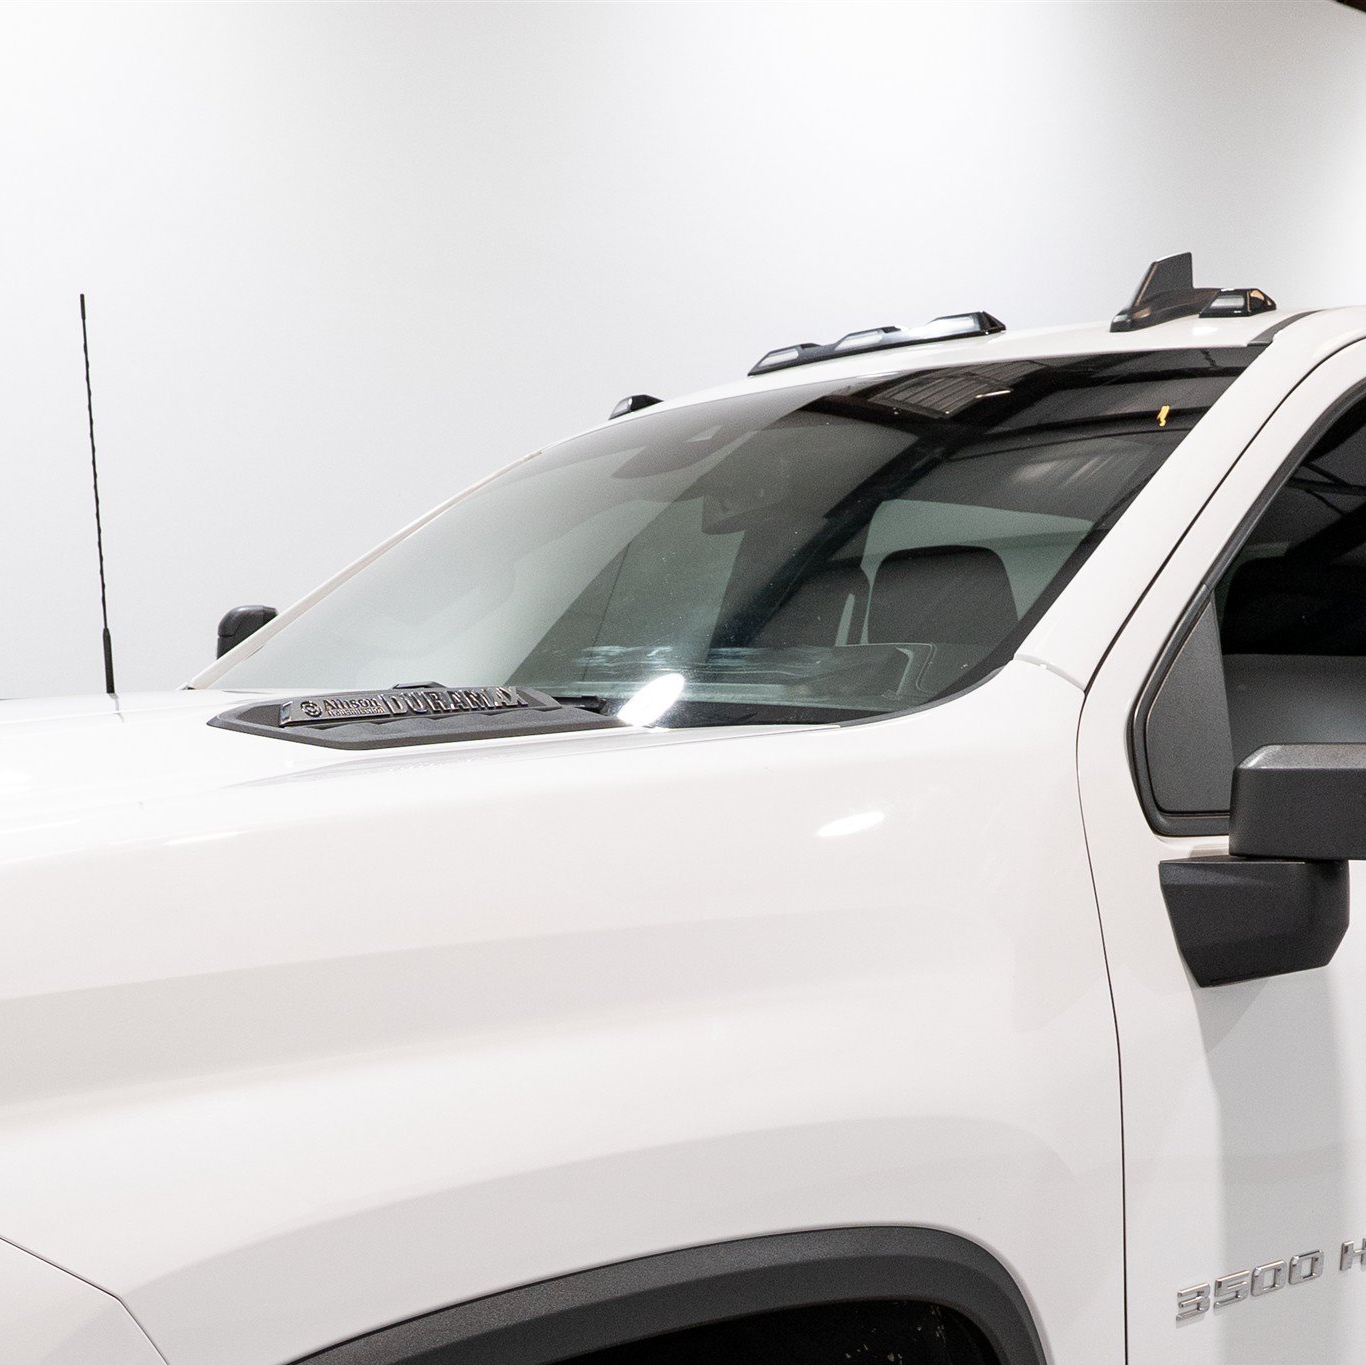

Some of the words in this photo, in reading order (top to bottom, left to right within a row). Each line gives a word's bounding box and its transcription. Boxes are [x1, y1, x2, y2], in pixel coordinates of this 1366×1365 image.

[323, 697, 382, 710] Allison
[378, 686, 529, 715] DURAMAX
[1175, 1248, 1325, 1322] 3500
